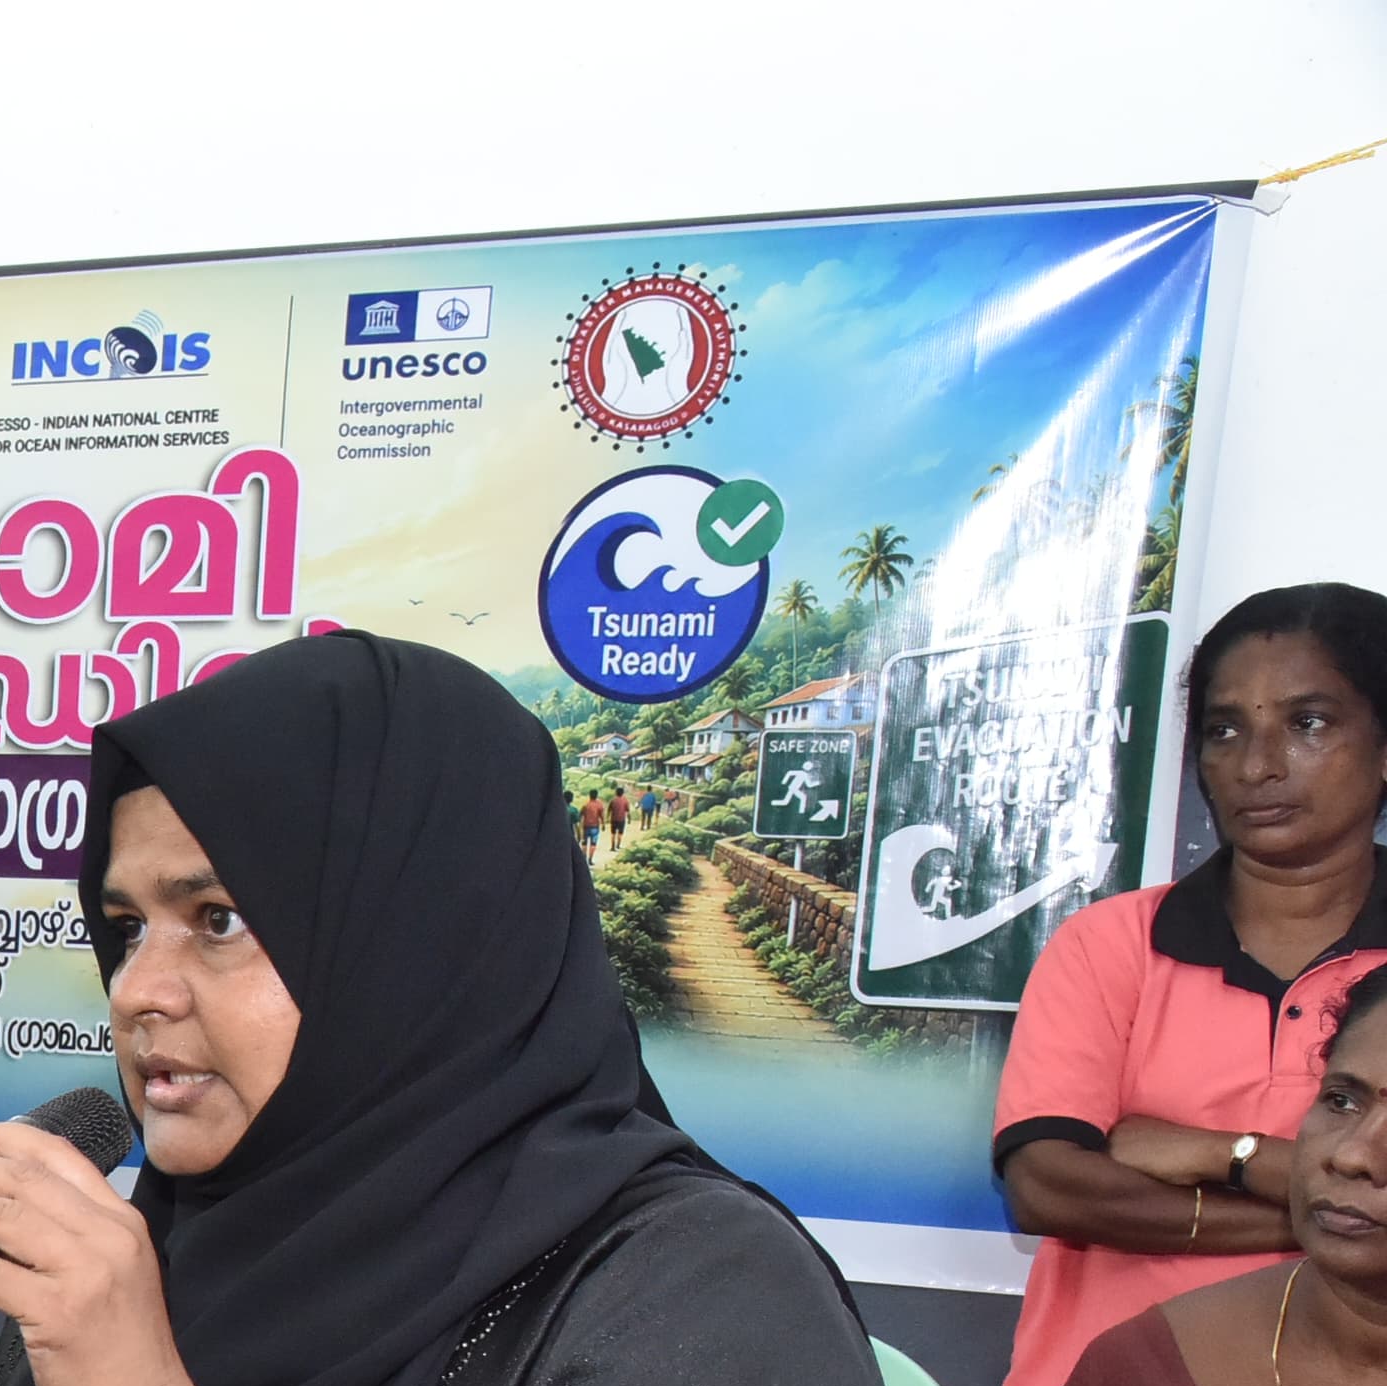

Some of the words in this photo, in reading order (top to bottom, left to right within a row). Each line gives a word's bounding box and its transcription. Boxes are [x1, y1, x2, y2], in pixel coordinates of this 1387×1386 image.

[11, 326, 212, 380] INCOIS
[572, 297, 616, 362] DISASTER
[622, 281, 716, 317] MANAGEMENT
[696, 322, 727, 407] AUTHORITY
[342, 351, 487, 381] unesco
[340, 393, 483, 416] Intergovernmental
[42, 414, 89, 430] INDIAN
[92, 411, 161, 427] NATIONAL
[165, 409, 220, 425] CENTRE
[338, 419, 455, 438] Oceanographic
[608, 417, 679, 432] KASARAGOD
[14, 437, 61, 453] OCEAN
[65, 433, 158, 450] INFORMATION
[163, 431, 229, 446] SERVICES
[337, 443, 431, 460] Commission
[587, 605, 716, 638] Tsunami
[601, 643, 696, 682] Ready
[944, 654, 1106, 709] TSUI
[769, 740, 805, 753] SAFE
[809, 739, 850, 753] ZONE
